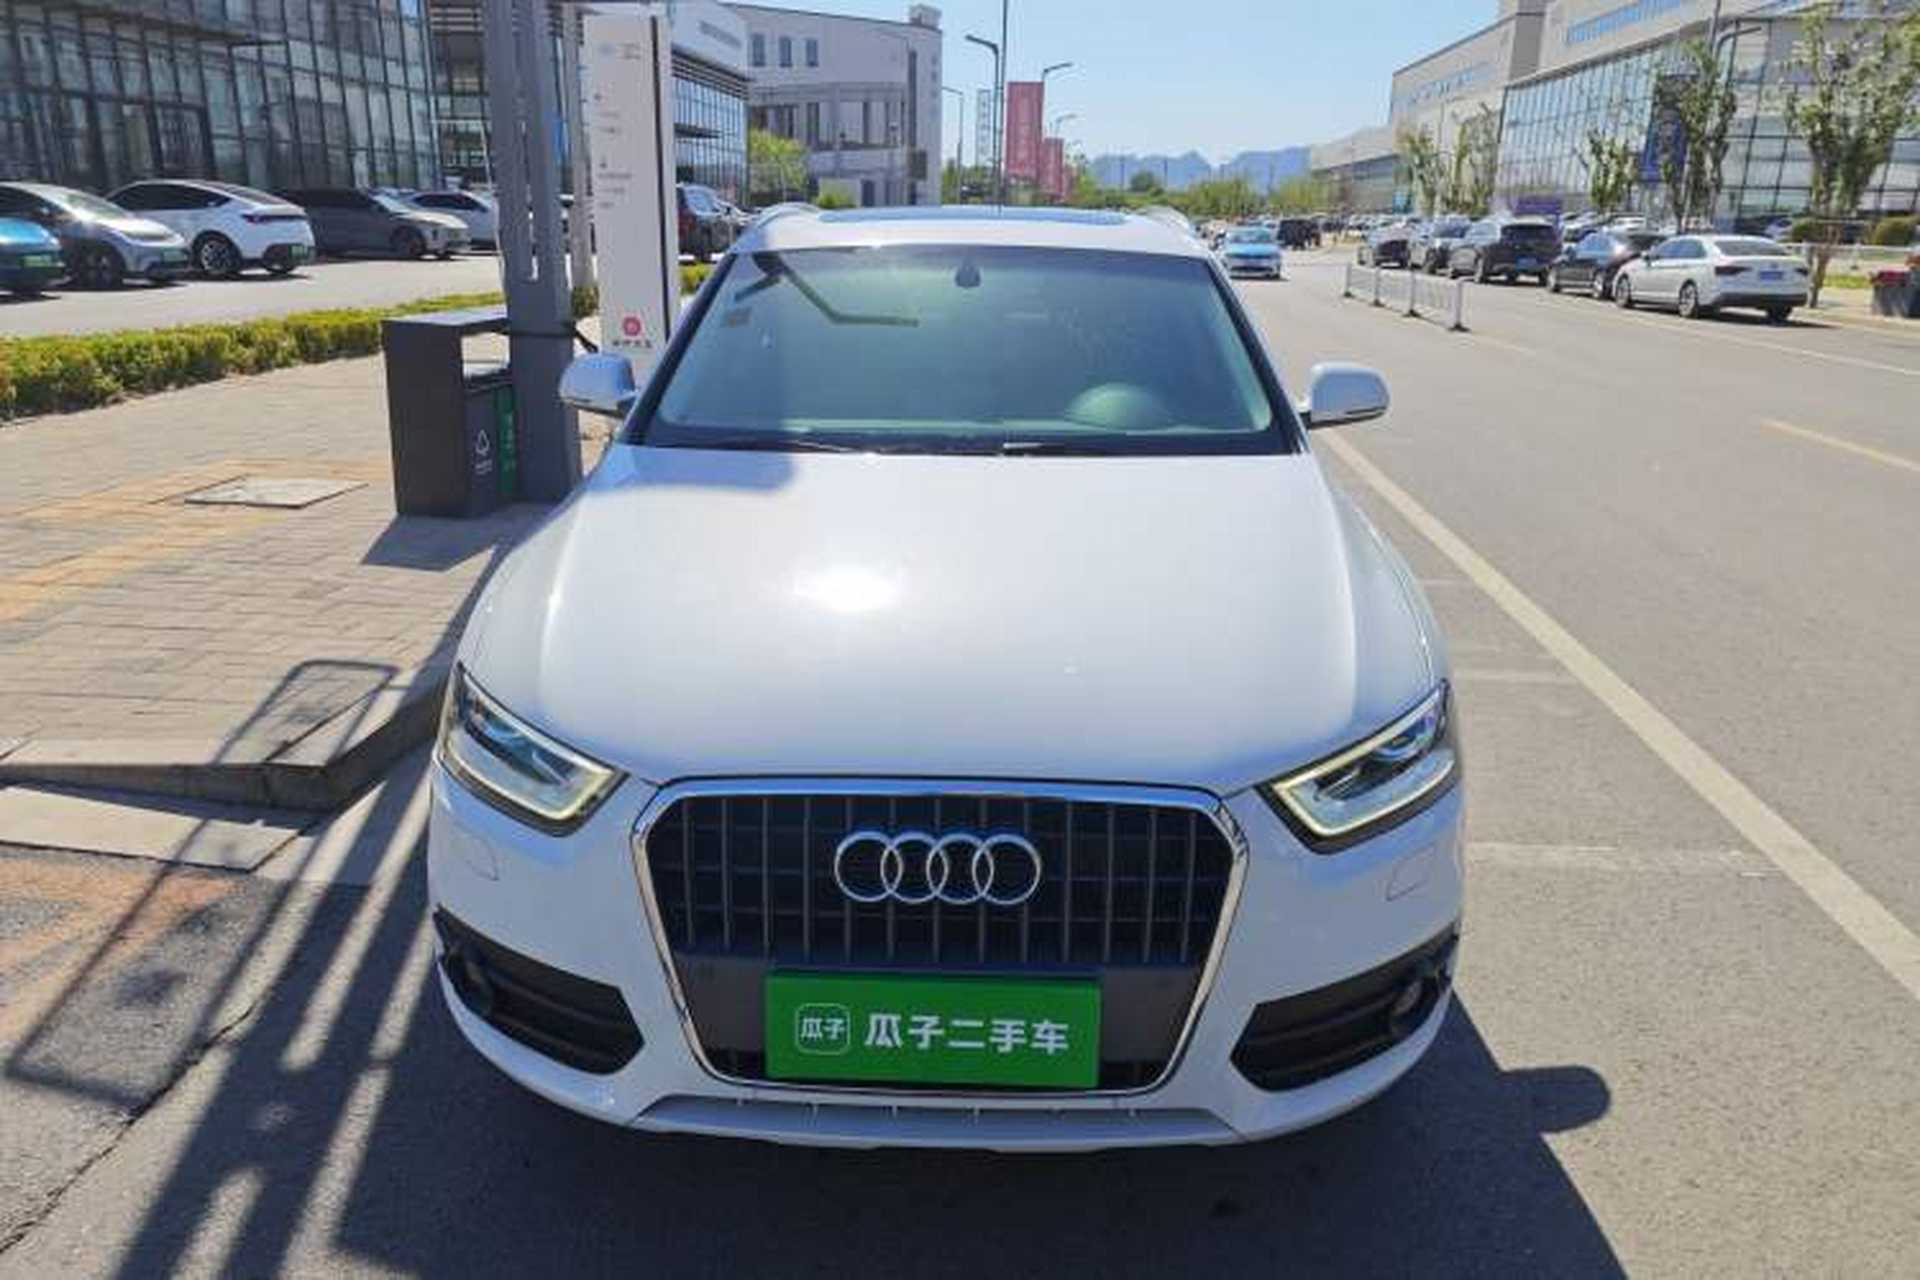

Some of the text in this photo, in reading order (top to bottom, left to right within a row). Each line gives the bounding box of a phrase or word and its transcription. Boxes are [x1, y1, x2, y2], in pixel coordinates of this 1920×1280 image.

[801, 1017, 847, 1041] 瓜子
[865, 1012, 1070, 1055] 瓜子二手车
